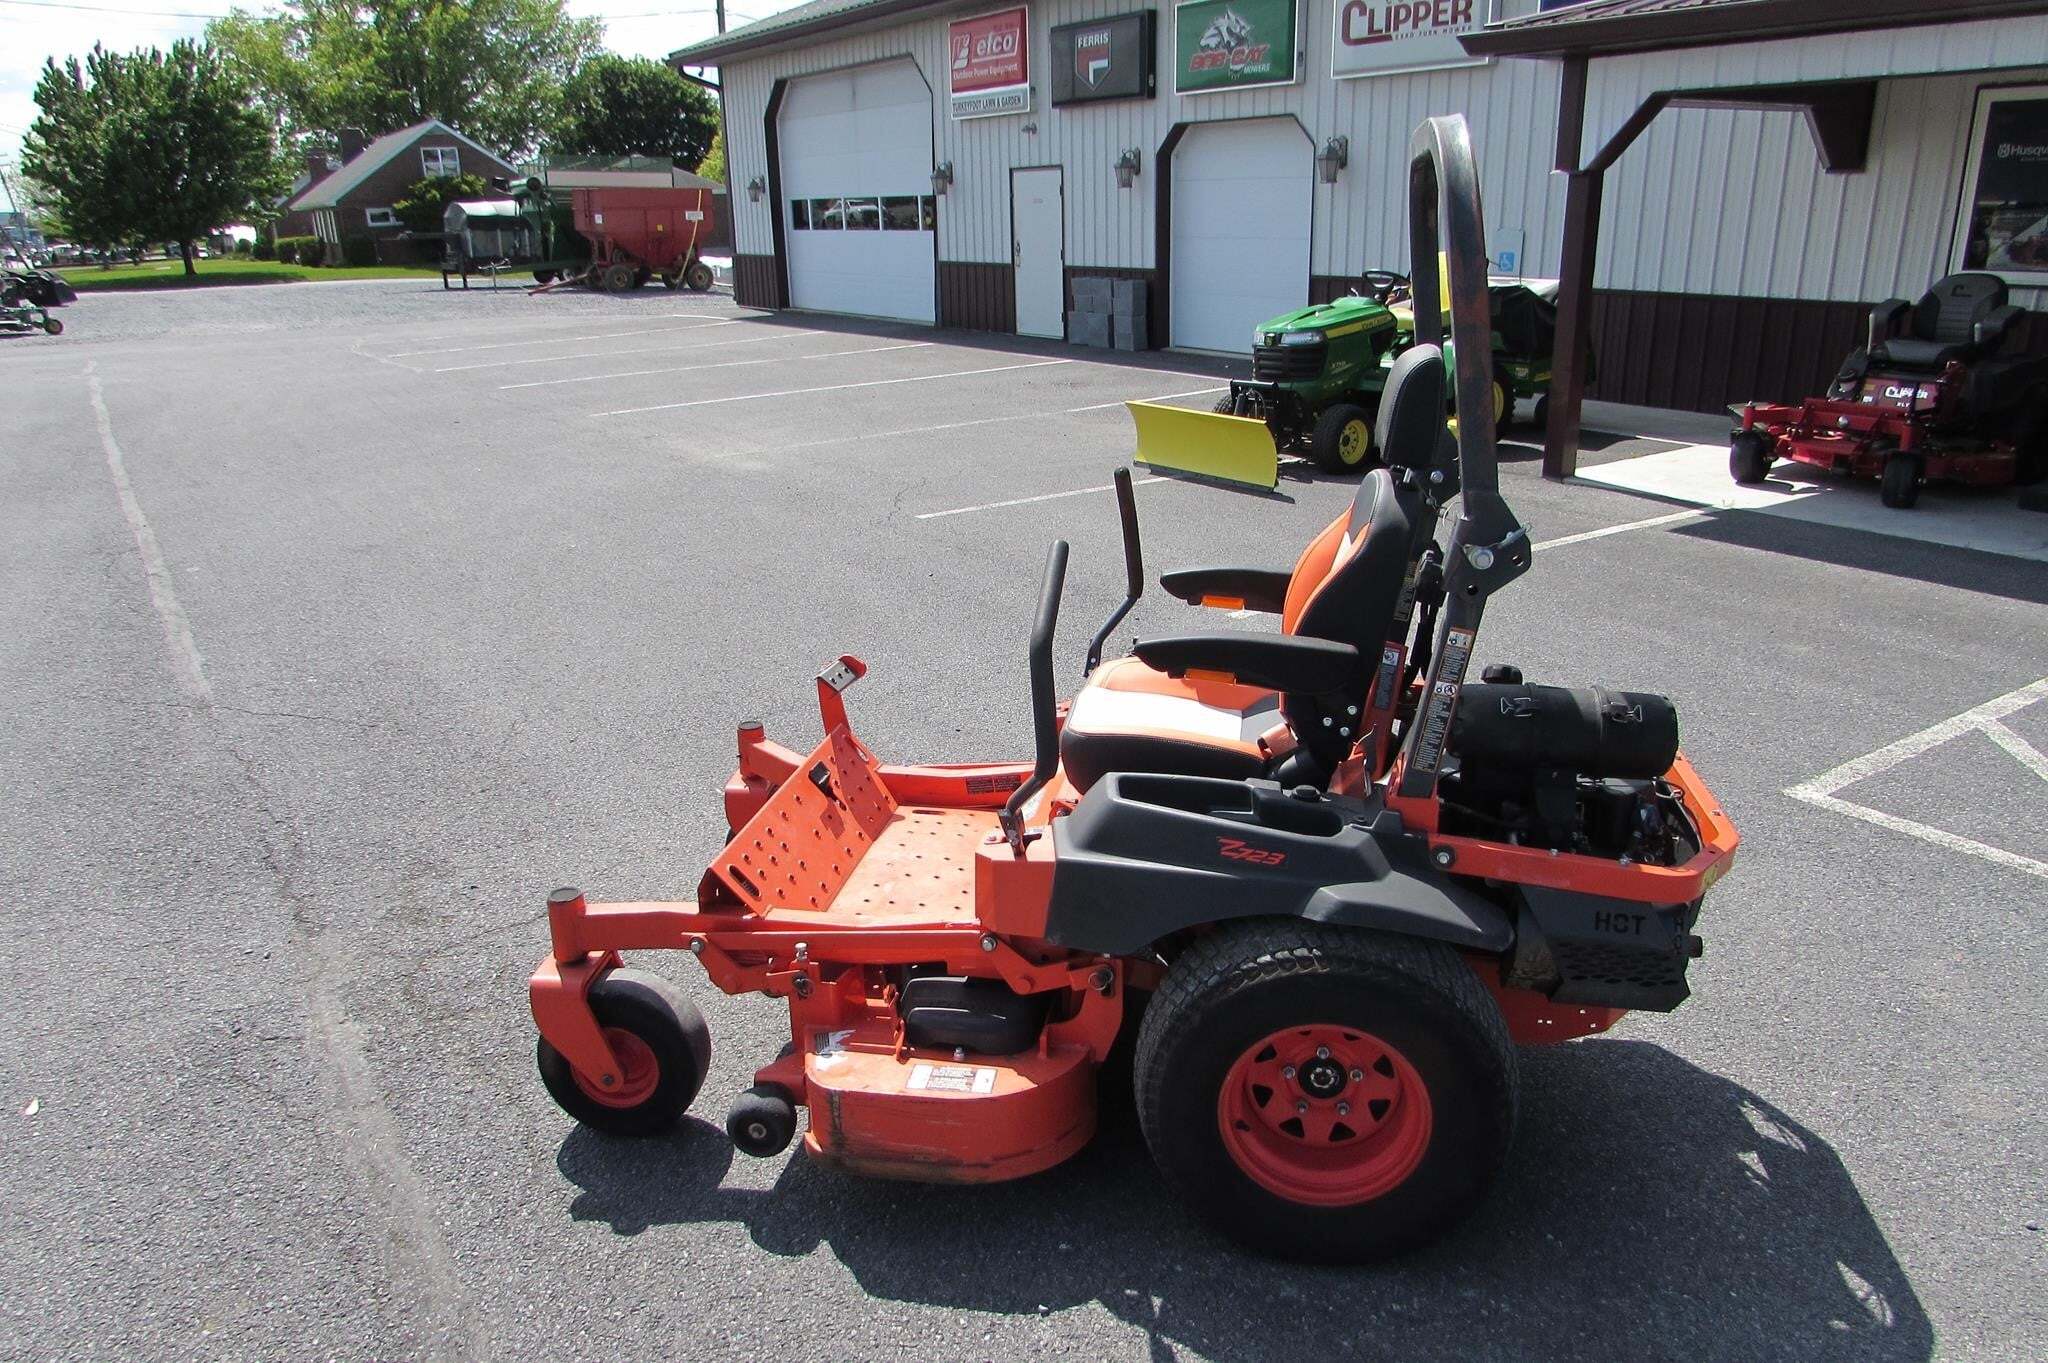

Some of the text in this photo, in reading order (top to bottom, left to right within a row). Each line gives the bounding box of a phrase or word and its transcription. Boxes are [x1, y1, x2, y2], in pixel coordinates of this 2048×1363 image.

[976, 32, 1013, 56] efco
[1078, 31, 1109, 49] FERRIS
[1216, 836, 1287, 865] Z723
[1594, 911, 1647, 935] HOT
